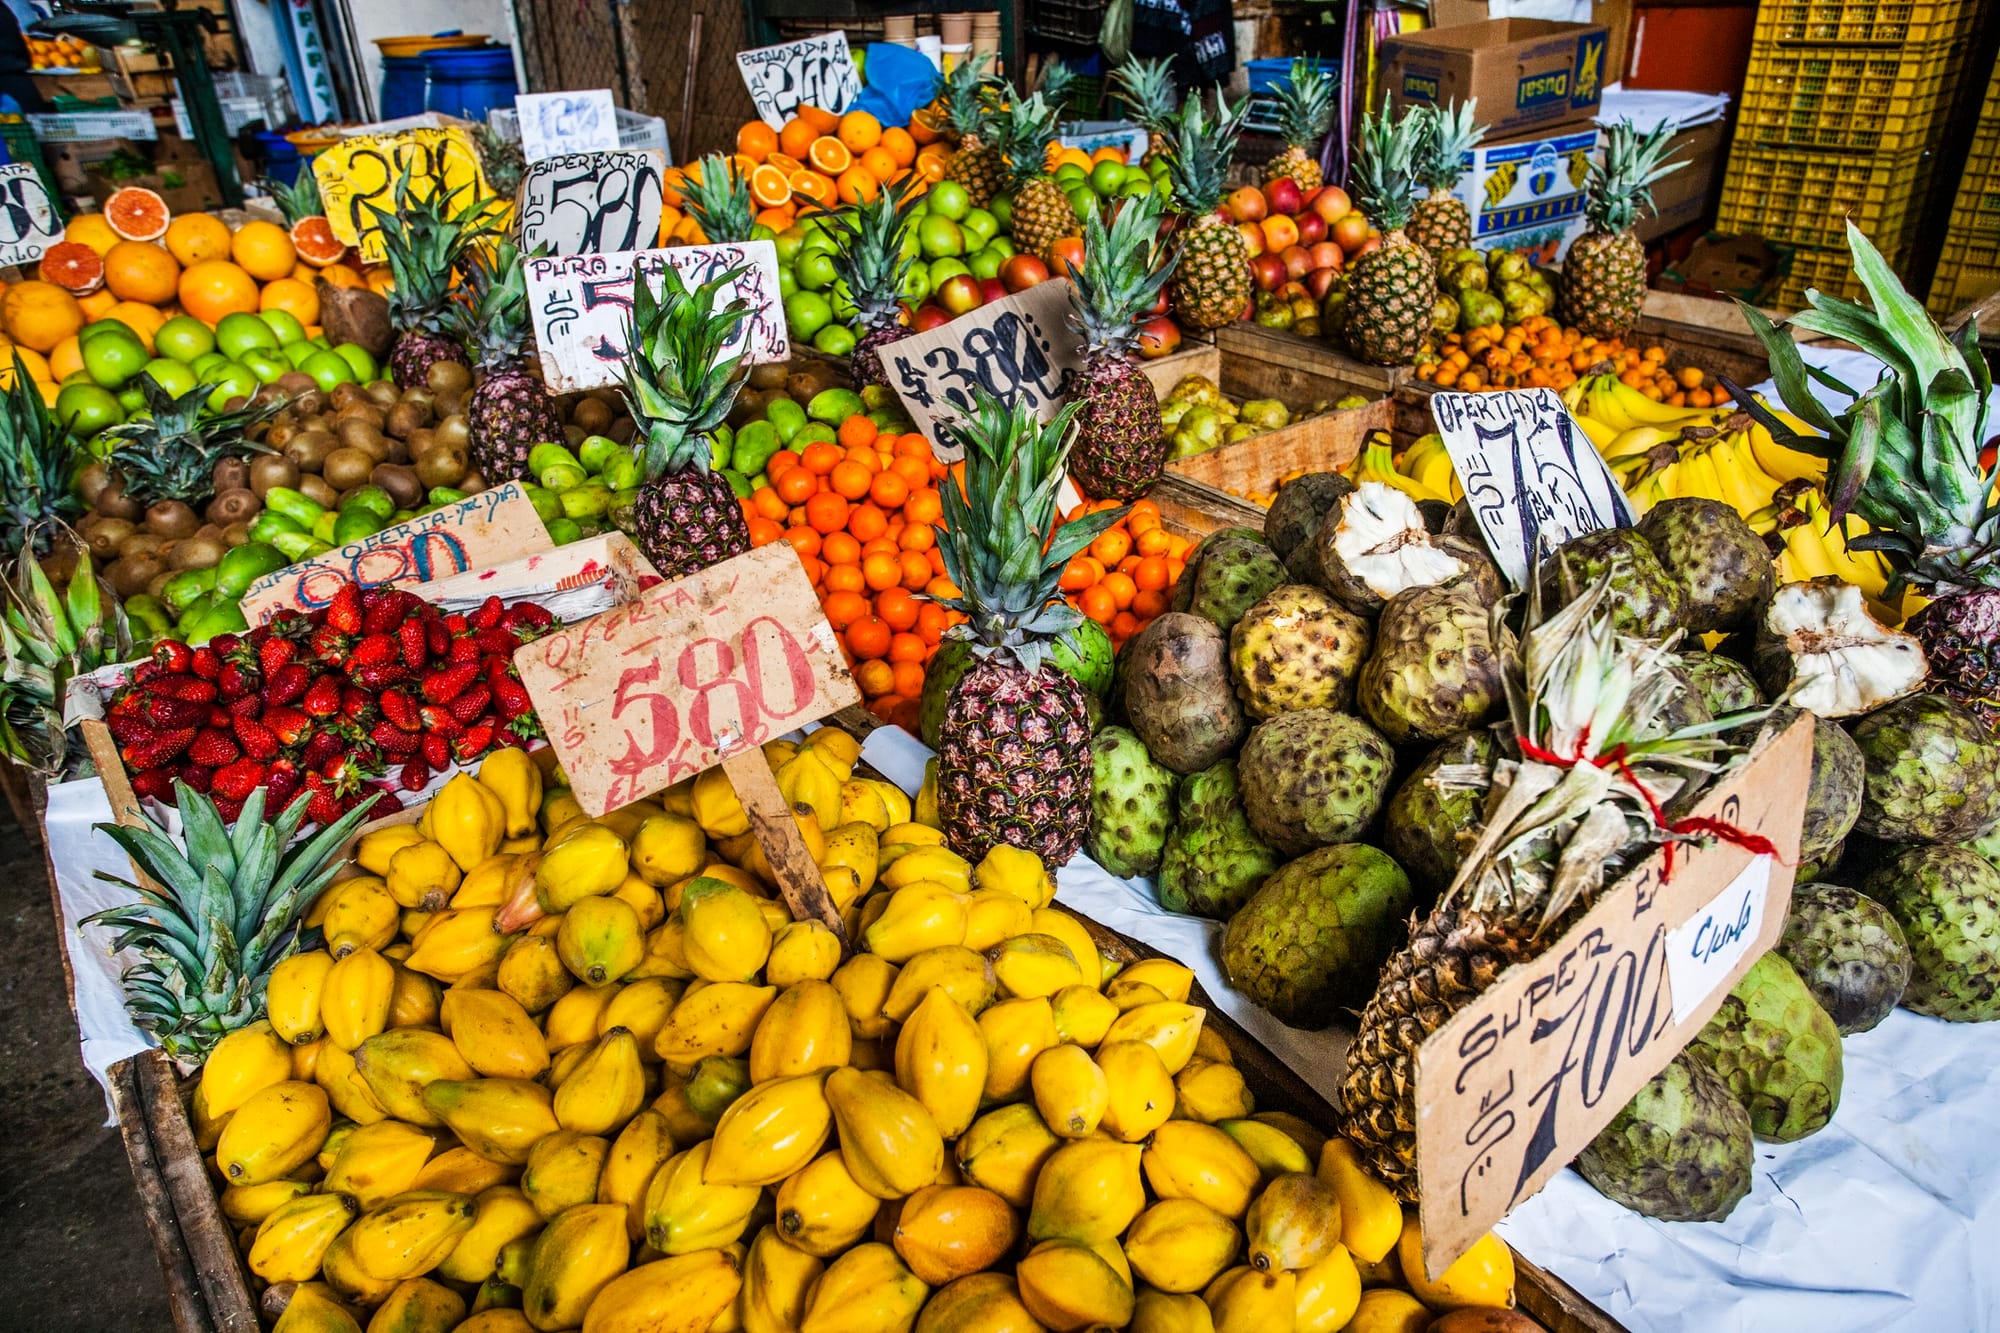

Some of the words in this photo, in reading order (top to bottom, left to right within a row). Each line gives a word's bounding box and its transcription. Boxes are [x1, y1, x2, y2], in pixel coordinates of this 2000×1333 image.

[1519, 73, 1567, 104] Dusal
[530, 153, 590, 188] SUPER
[593, 151, 648, 171] EXTRA
[548, 167, 664, 253] 580
[529, 256, 607, 281] PURA
[545, 587, 695, 669] OFERTA
[608, 615, 816, 776] 580
[1455, 926, 1612, 1094] SUPER
